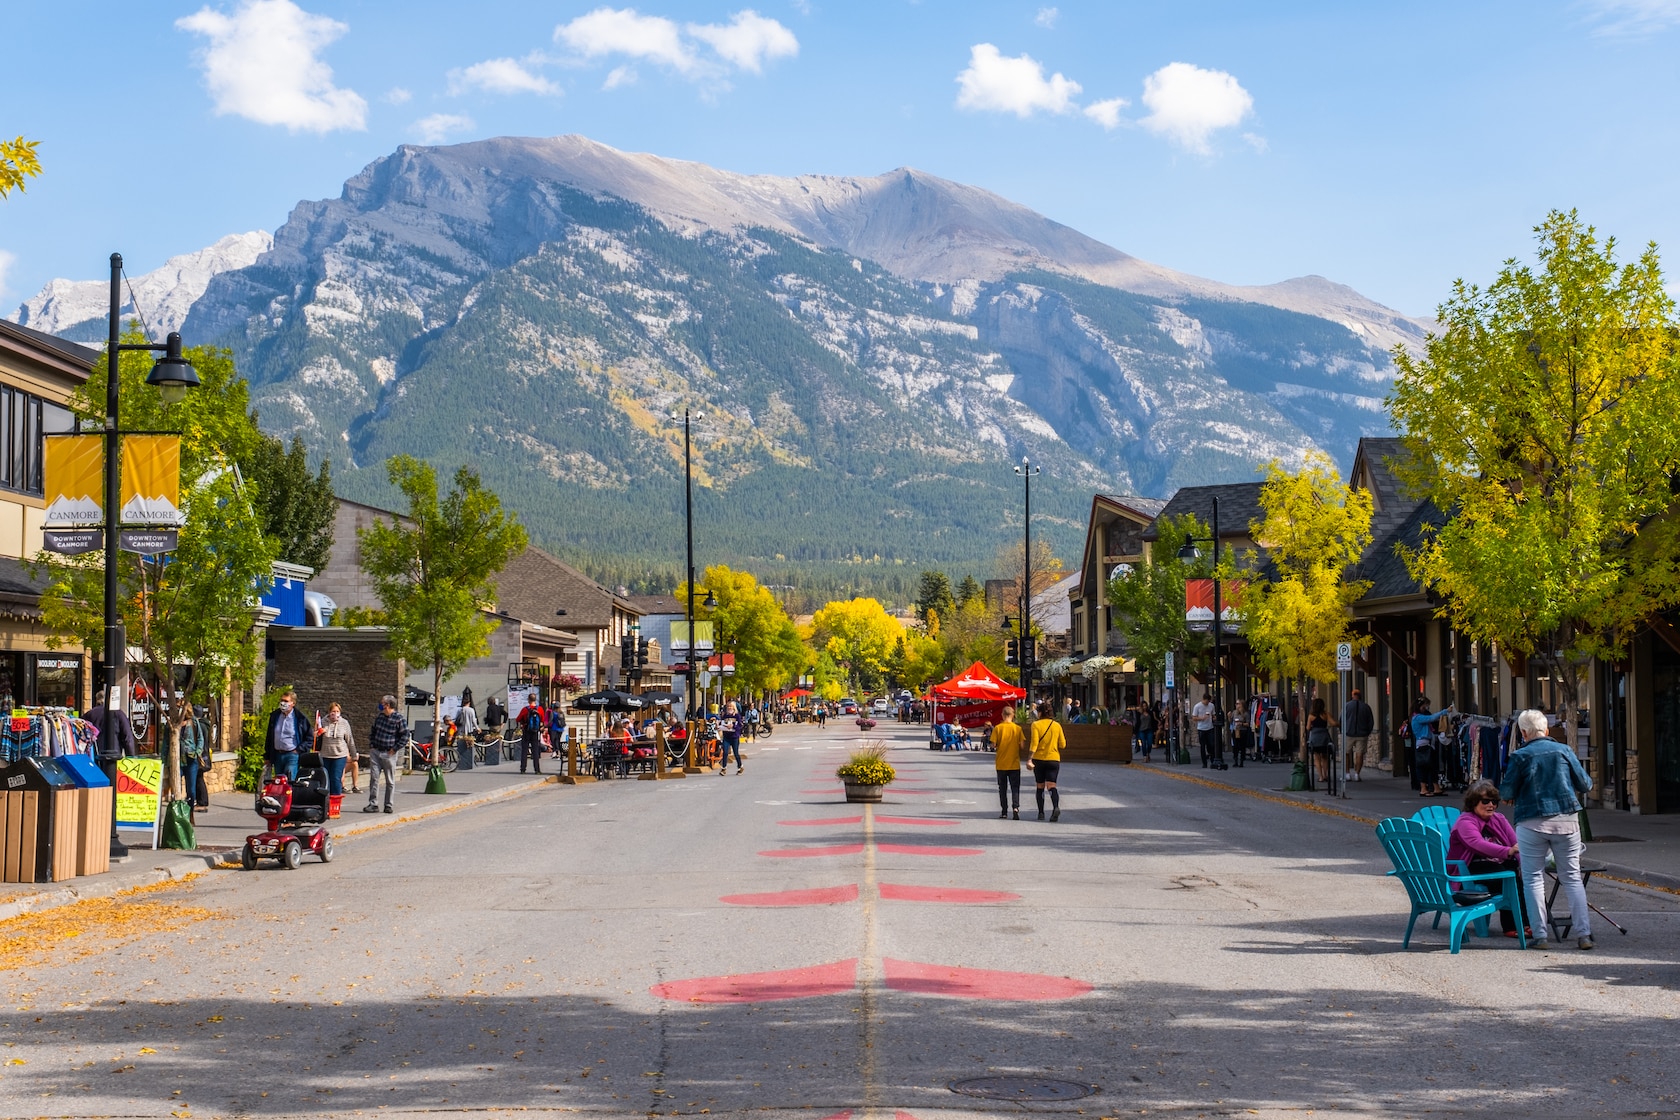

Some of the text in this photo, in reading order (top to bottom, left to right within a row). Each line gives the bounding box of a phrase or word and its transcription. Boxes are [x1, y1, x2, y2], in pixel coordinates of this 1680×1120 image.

[49, 511, 99, 520] CANMORE
[125, 510, 175, 519] CANMORE
[118, 757, 161, 787] SALE
[118, 775, 138, 792] 0%
